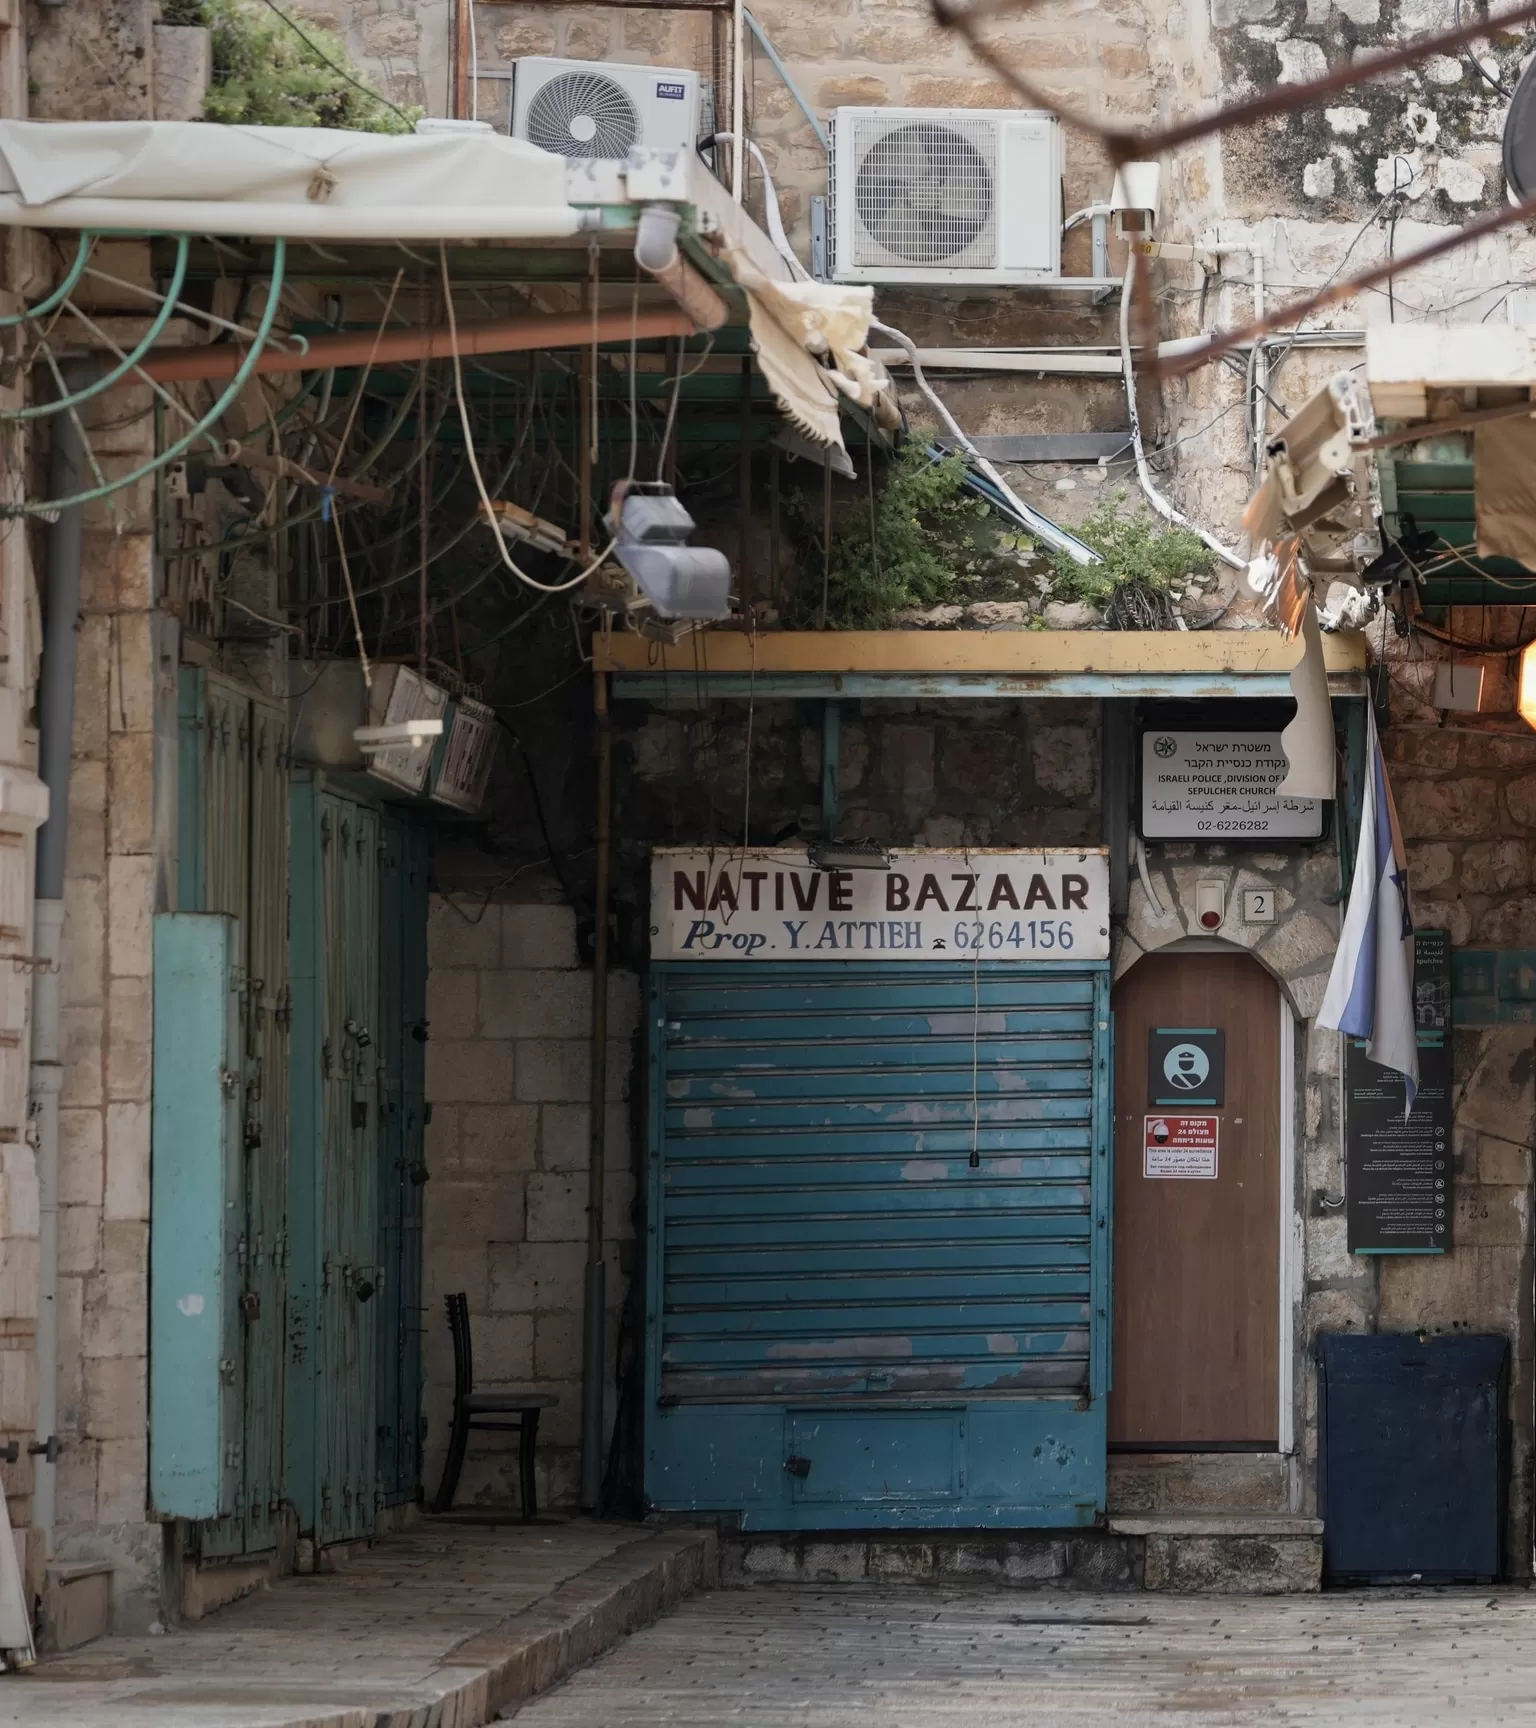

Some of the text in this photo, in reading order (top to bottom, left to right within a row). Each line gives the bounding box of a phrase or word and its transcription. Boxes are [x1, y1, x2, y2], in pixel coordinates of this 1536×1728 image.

[1195, 741, 1271, 752] משטרת ישראל
[1184, 758, 1285, 769] נקודת כנסיית הקבר
[1158, 774, 1190, 783] ISRAELI
[1192, 774, 1222, 783] POLICE
[1268, 774, 1282, 783] OF
[1188, 787, 1276, 796] SEPULCHER CHURCH
[1152, 801, 1183, 813] القيامة
[1186, 800, 1215, 813] كنيسة
[1282, 800, 1315, 813] شرطة
[1197, 820, 1269, 831] 02-6226282
[673, 871, 1090, 911] NATIVE BAZAAR
[1253, 895, 1266, 914] 2
[680, 919, 778, 956] Prop.
[953, 920, 1074, 950] 6264156
